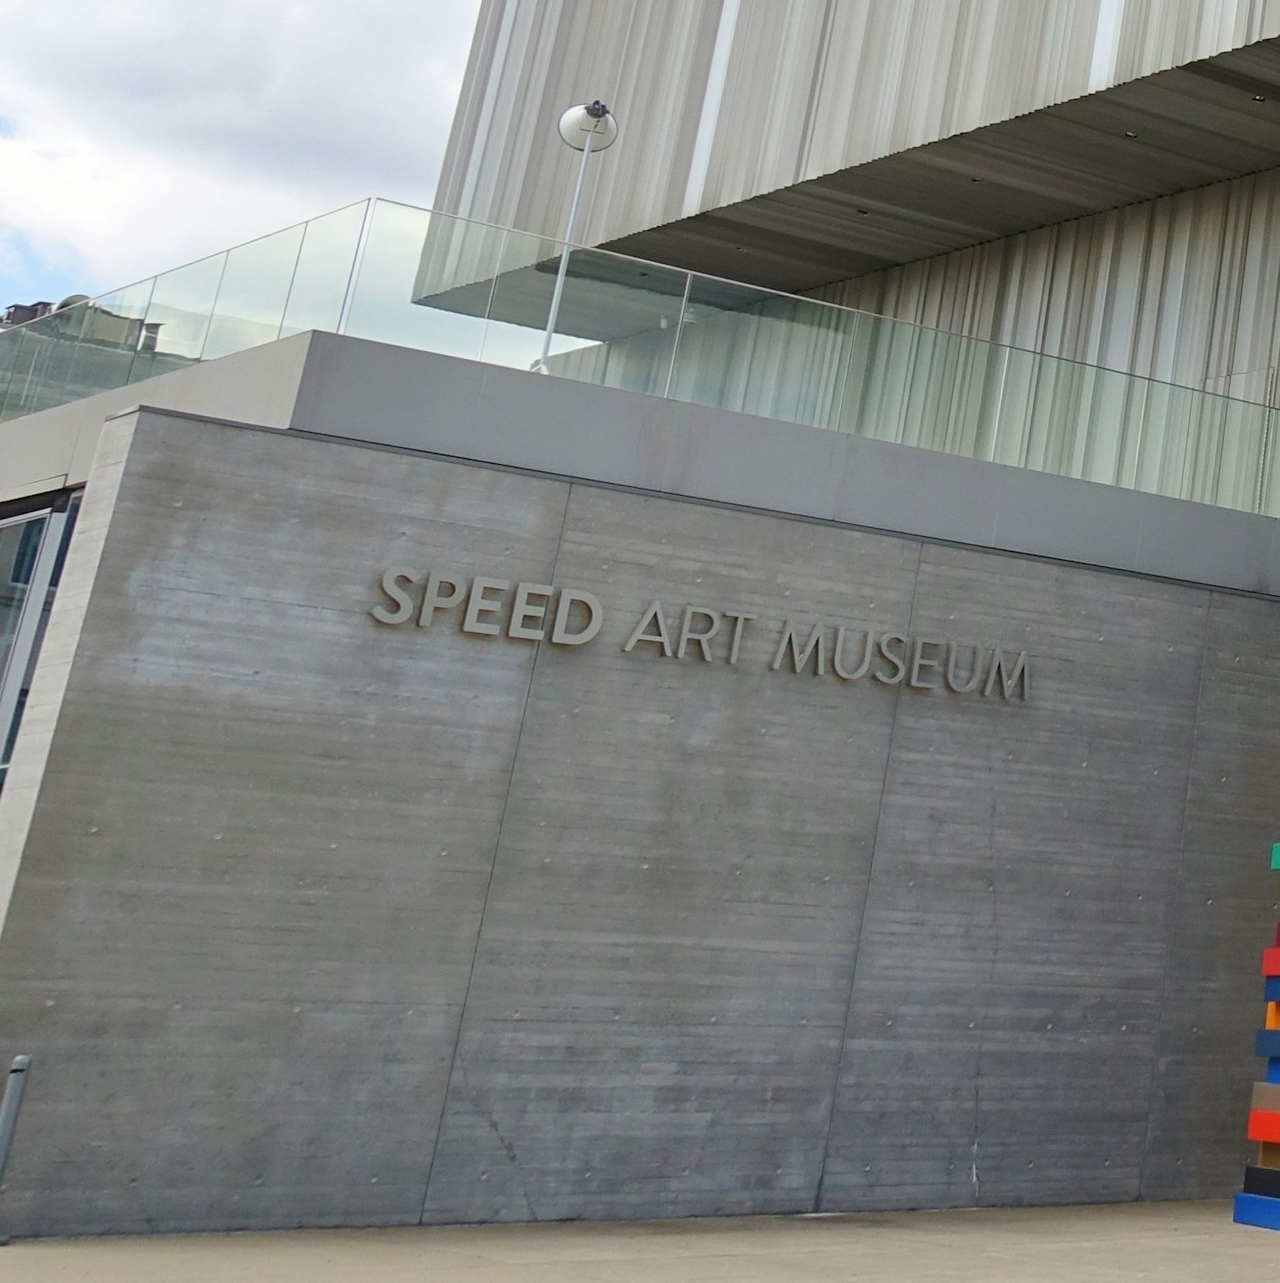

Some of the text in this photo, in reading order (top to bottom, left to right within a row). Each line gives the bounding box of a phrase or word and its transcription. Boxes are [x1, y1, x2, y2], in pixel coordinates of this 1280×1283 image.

[369, 566, 1032, 701] SPEED ART MUSEUM
